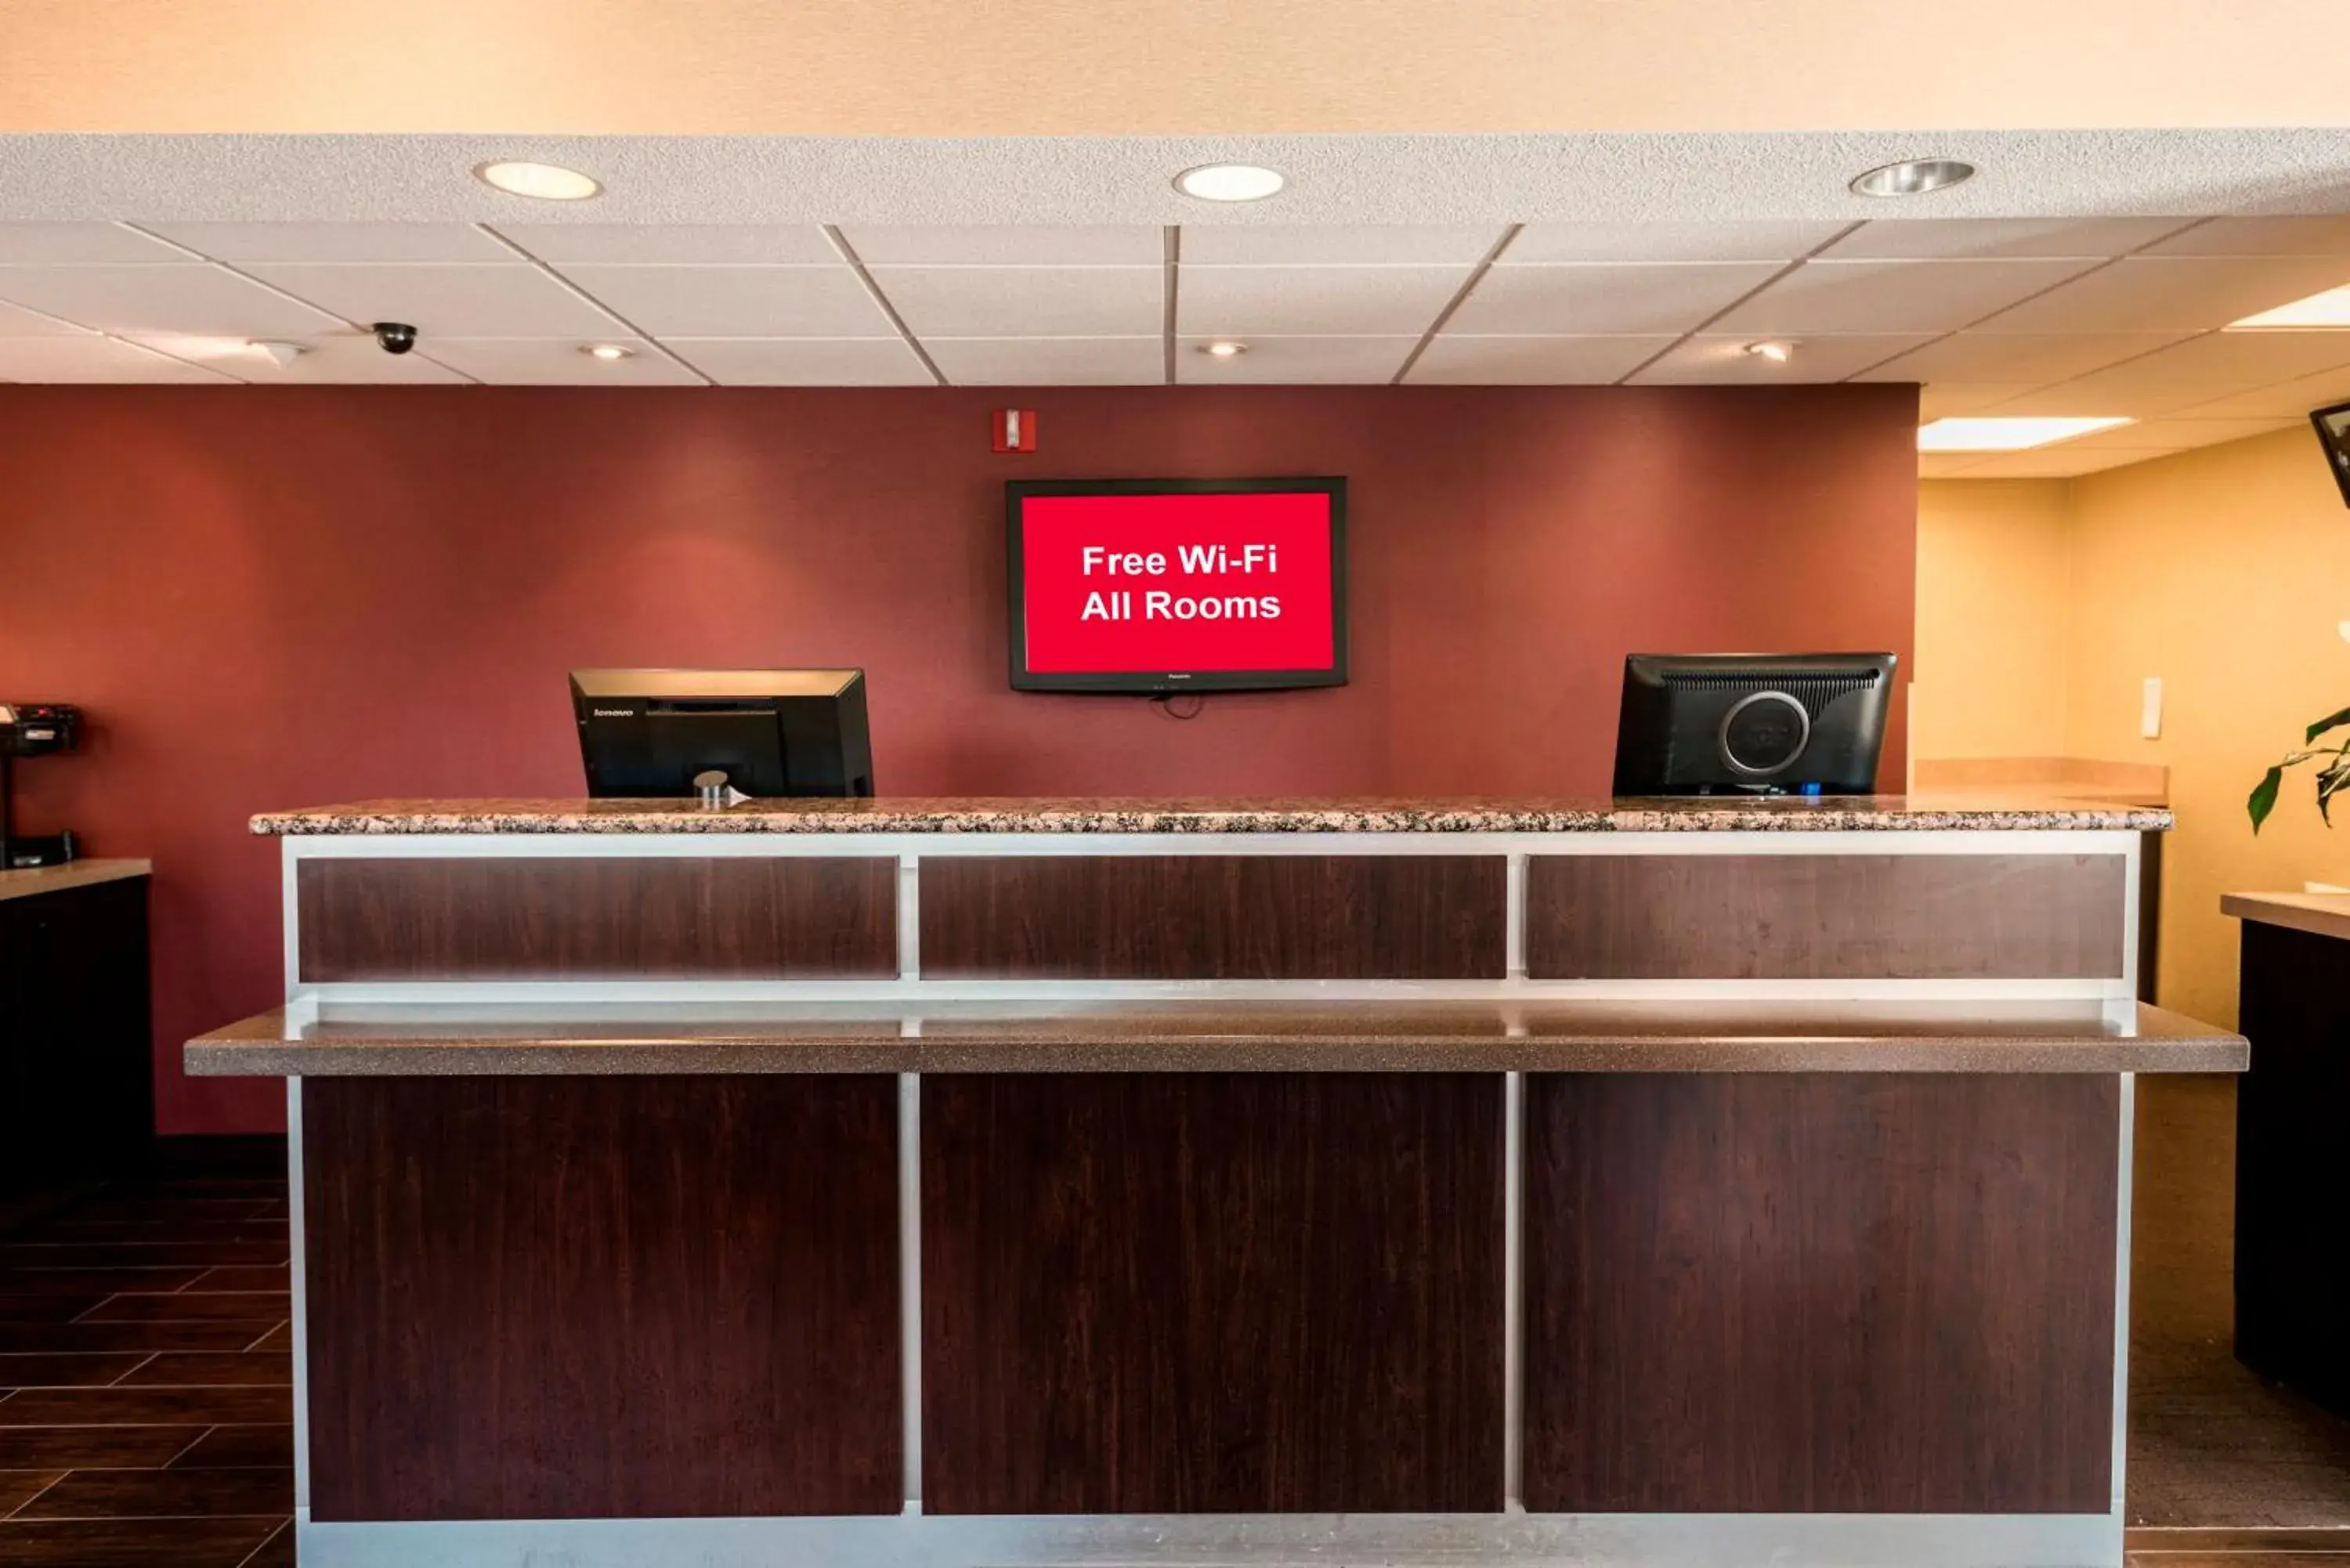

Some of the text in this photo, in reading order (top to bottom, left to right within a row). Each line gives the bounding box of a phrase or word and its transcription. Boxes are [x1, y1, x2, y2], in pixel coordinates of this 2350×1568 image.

[1083, 544, 1277, 575] Free Wi-Fi
[1081, 591, 1281, 621] All Rooms
